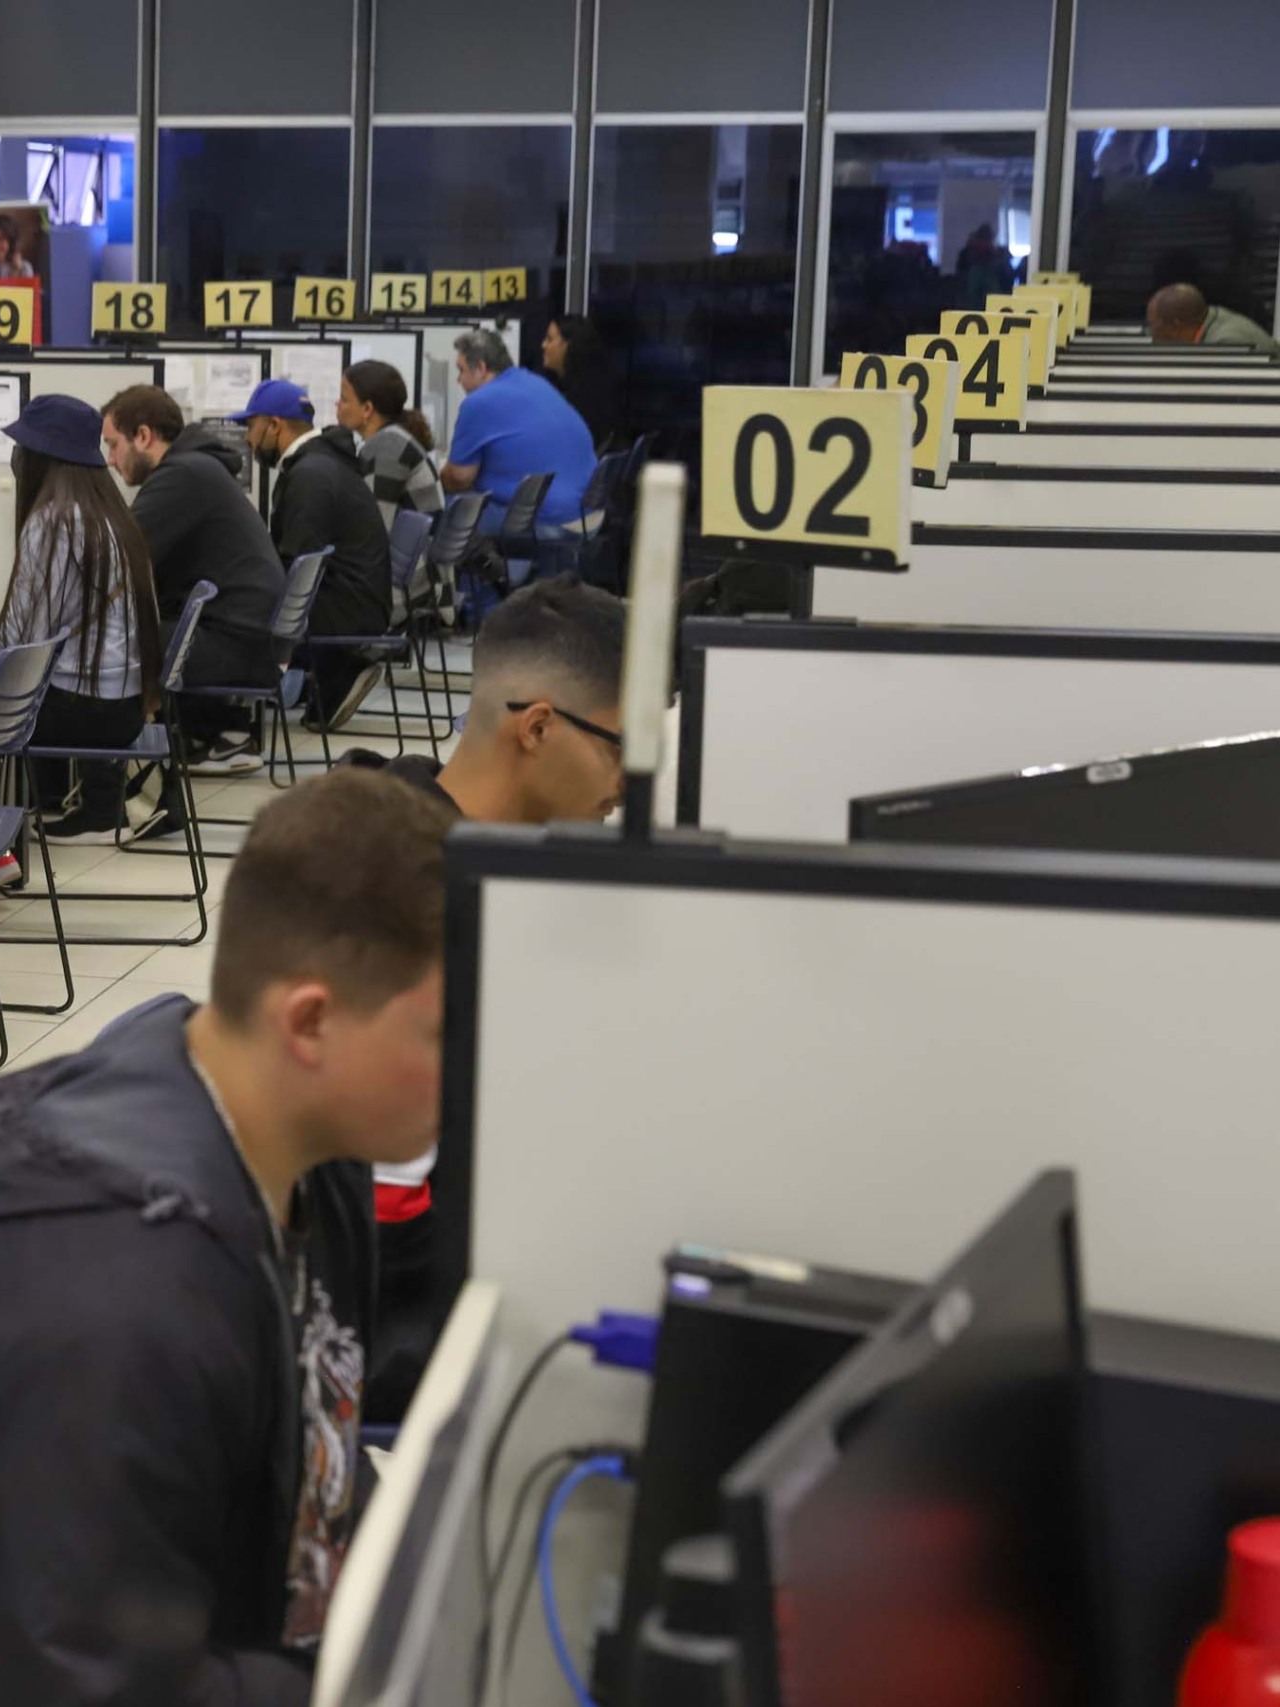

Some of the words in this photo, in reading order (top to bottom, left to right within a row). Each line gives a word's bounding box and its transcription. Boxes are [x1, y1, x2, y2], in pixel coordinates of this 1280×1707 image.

[305, 285, 346, 316] 16
[380, 281, 418, 310] 15
[439, 277, 472, 304] 14
[490, 275, 519, 302] 13
[104, 291, 154, 330] 18
[214, 288, 261, 323] 17
[733, 412, 872, 537] 02
